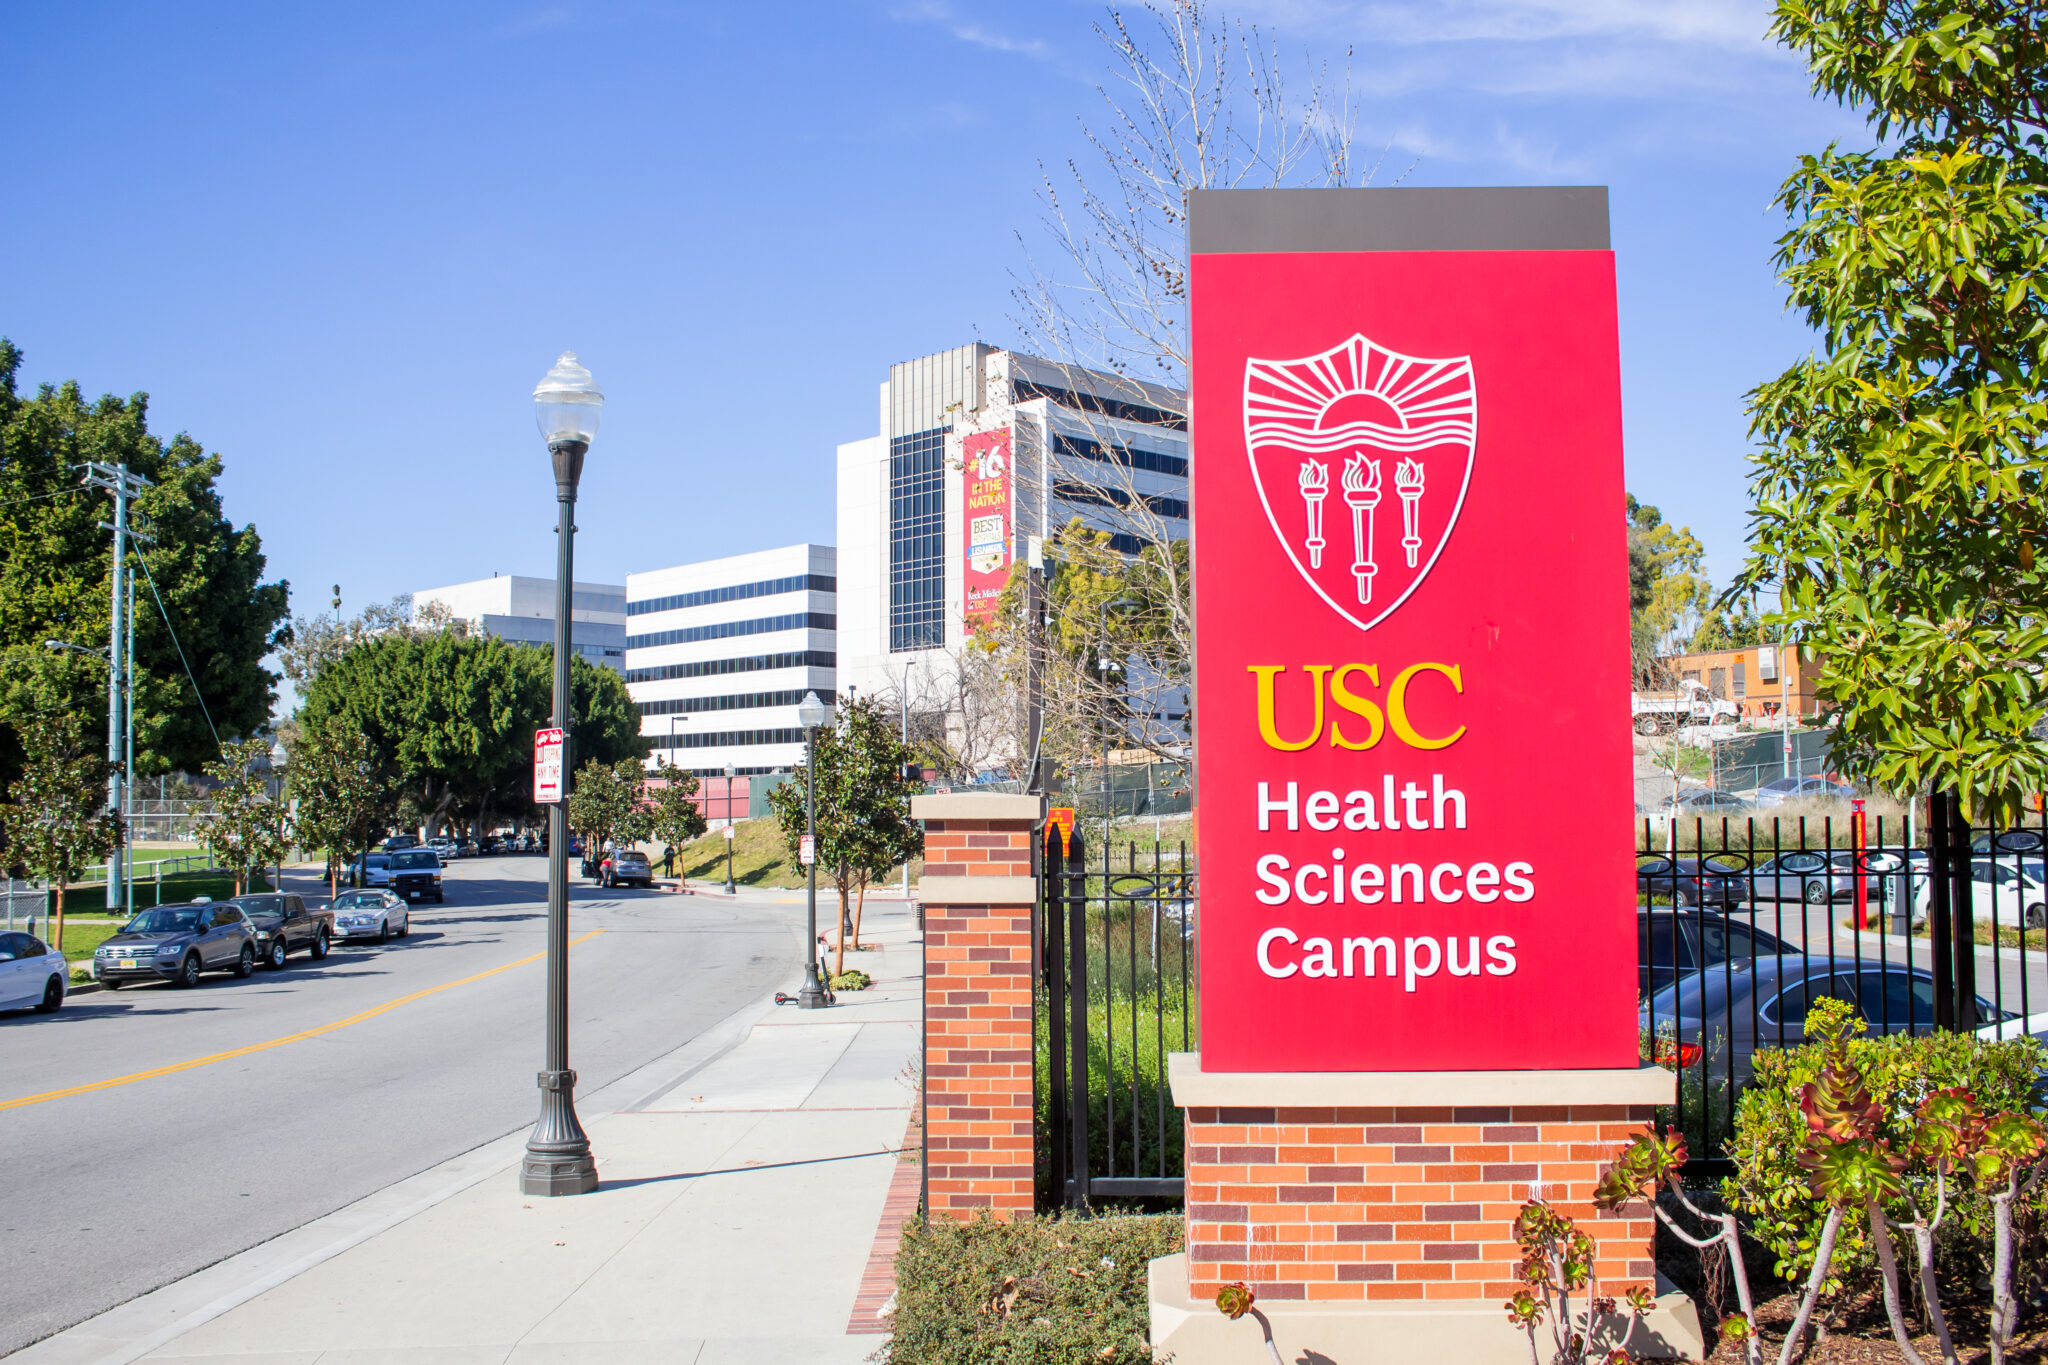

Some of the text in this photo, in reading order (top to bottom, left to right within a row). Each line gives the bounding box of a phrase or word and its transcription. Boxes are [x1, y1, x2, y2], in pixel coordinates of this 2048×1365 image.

[968, 445, 1005, 480] #16
[969, 492, 1005, 509] NATION
[972, 479, 1002, 495] IN THE
[973, 518, 1000, 534] BEST
[1247, 662, 1467, 752] USC
[537, 764, 560, 779] ANY TIME
[1257, 774, 1468, 832] Health
[1255, 848, 1536, 906] Sciences
[1256, 927, 1518, 993] Campus
